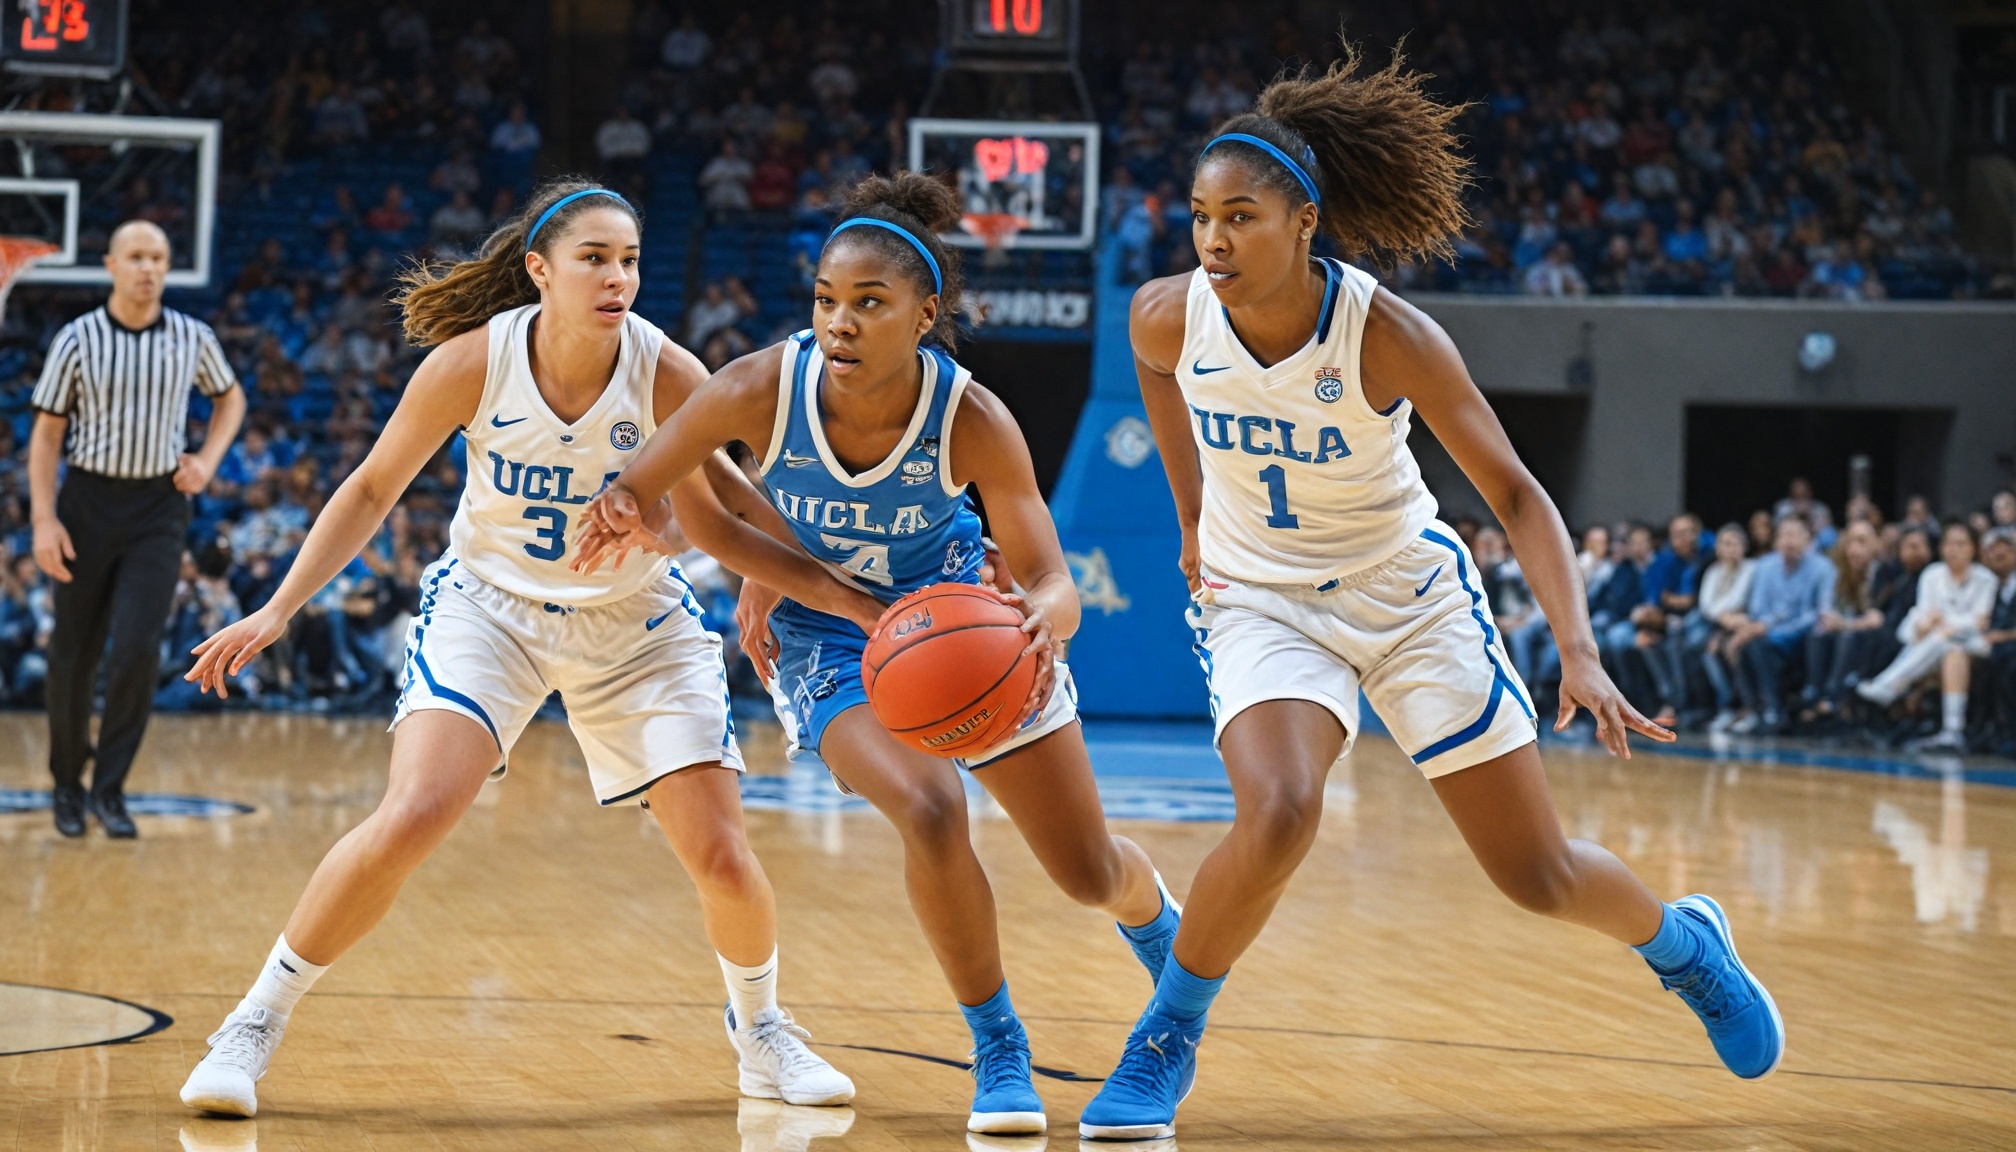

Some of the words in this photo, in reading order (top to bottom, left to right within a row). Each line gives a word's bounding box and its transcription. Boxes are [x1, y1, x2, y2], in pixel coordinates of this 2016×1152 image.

[1188, 402, 1353, 464] UCLA
[1258, 463, 1300, 530] 1
[522, 505, 568, 562] 3
